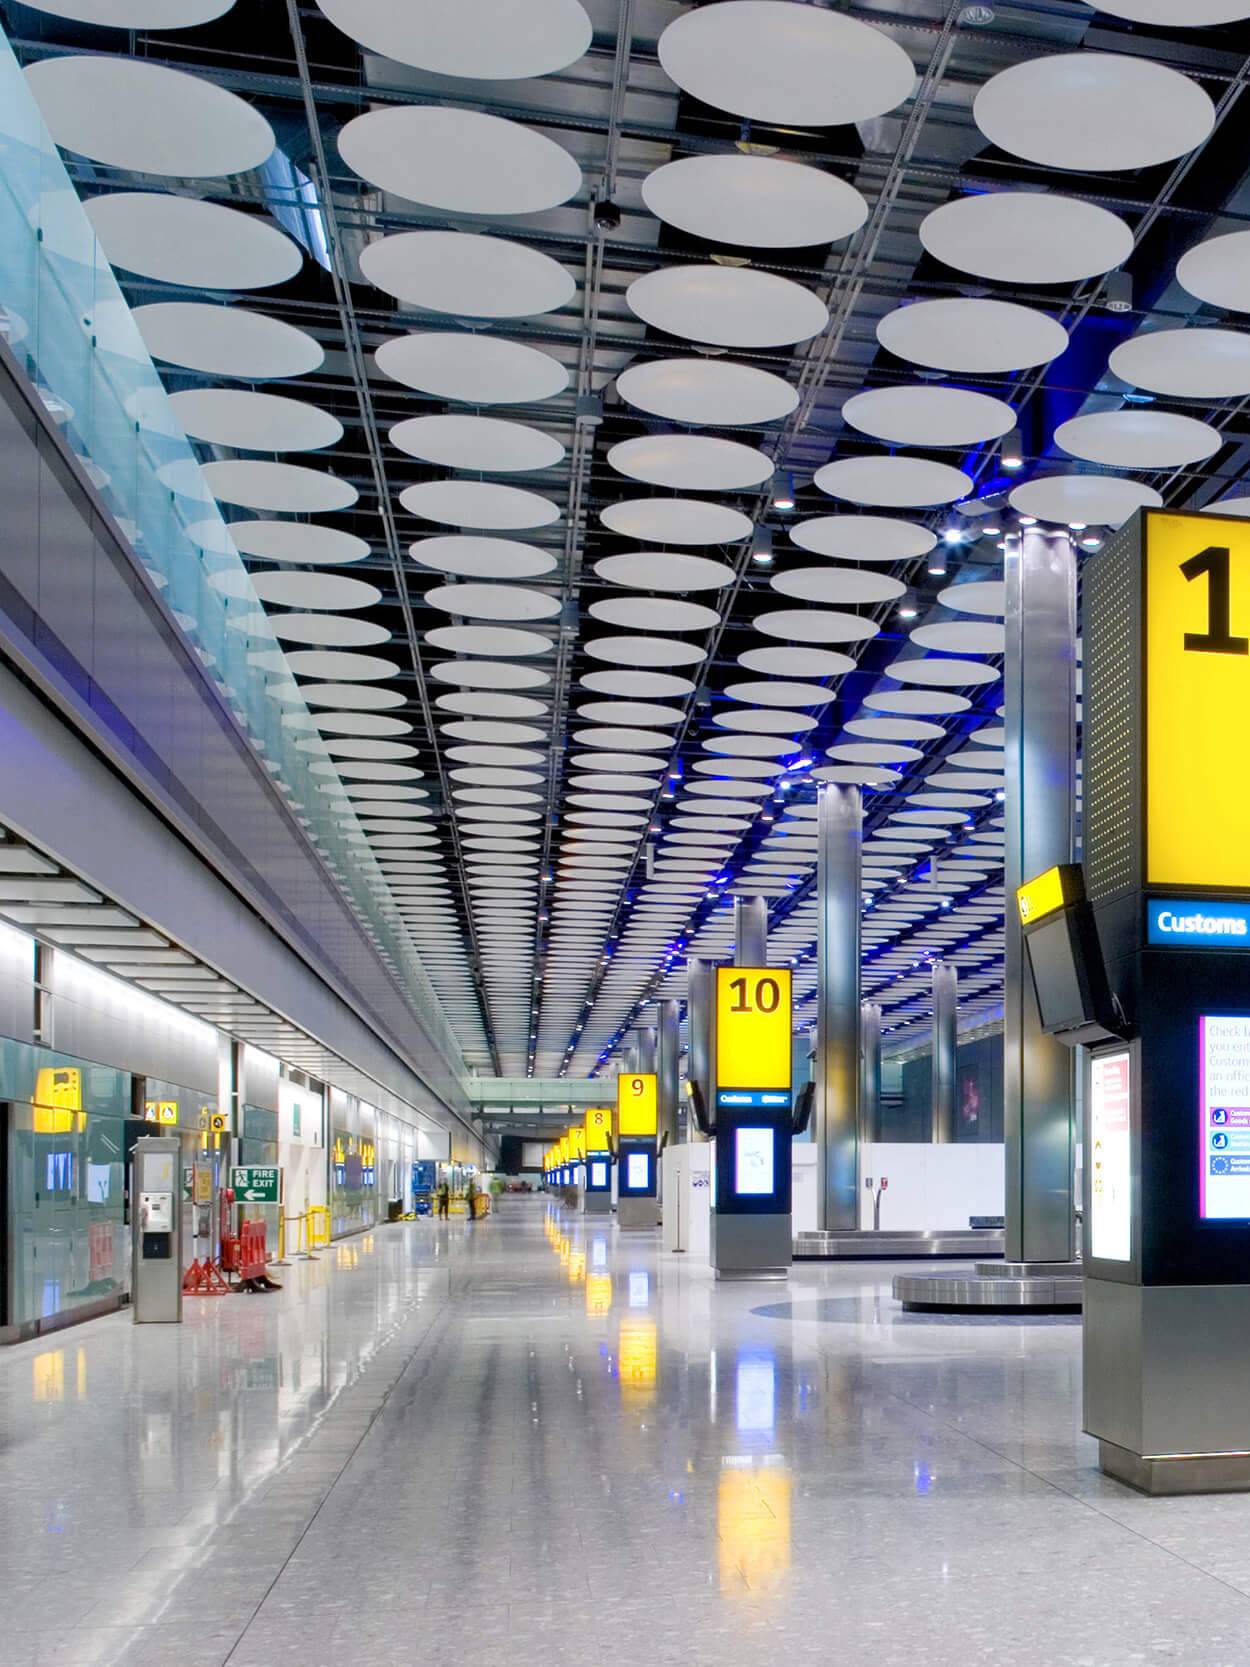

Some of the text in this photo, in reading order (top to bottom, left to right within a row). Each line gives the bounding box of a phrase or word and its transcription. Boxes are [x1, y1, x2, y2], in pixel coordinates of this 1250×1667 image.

[1158, 912, 1247, 935] Customs
[730, 977, 780, 1013] 10
[1209, 1025, 1240, 1037] Check
[1209, 1043, 1230, 1054] you
[1210, 1071, 1223, 1081] an
[632, 1079, 644, 1096] 9
[1209, 1086, 1227, 1097] the
[1231, 1086, 1248, 1097] red
[594, 1113, 603, 1124] 8
[575, 1130, 582, 1138] 7
[253, 1170, 275, 1178] FIRE
